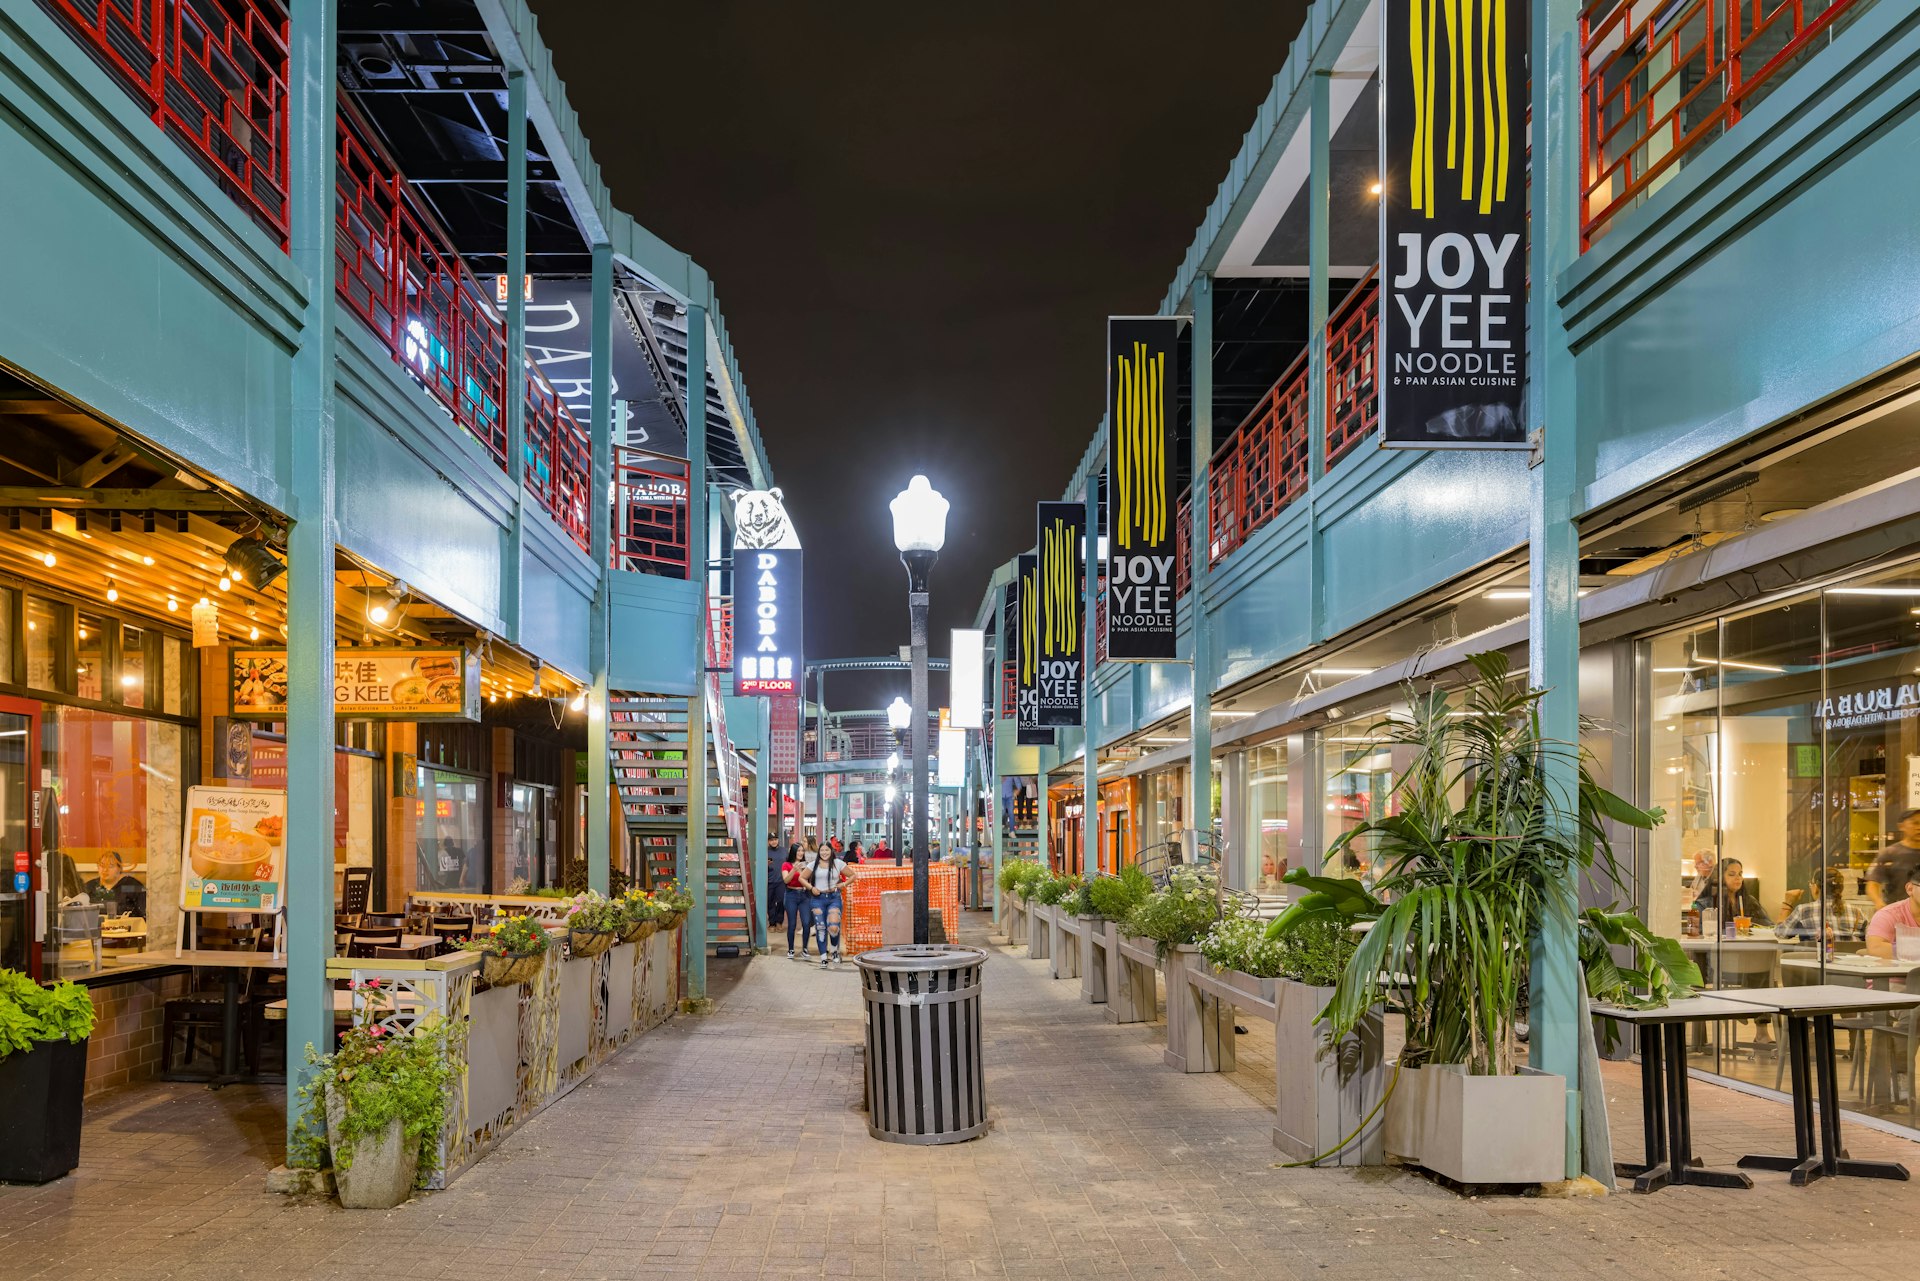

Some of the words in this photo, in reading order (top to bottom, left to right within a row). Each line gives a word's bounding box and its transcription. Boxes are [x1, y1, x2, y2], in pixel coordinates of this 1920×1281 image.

[1395, 232, 1521, 289] JOY
[1394, 294, 1511, 348] YEE
[1395, 353, 1516, 373] NOODLE
[1393, 377, 1401, 386] &
[1406, 377, 1428, 386] PAN
[1432, 377, 1466, 386] ASIAN
[1470, 377, 1517, 386] CUISINE
[1112, 555, 1175, 585] JOY
[757, 553, 778, 652] DABOBA
[1112, 586, 1171, 614] YEE
[1112, 615, 1172, 626] NOODLE
[335, 661, 377, 683] 味佳
[1040, 661, 1080, 679] JOY
[354, 686, 389, 702] KEE
[742, 681, 757, 690] 2ND
[759, 681, 792, 690] FLOOR
[1040, 680, 1077, 698] YEE
[1020, 690, 1037, 705] JO
[1020, 706, 1037, 720] YE
